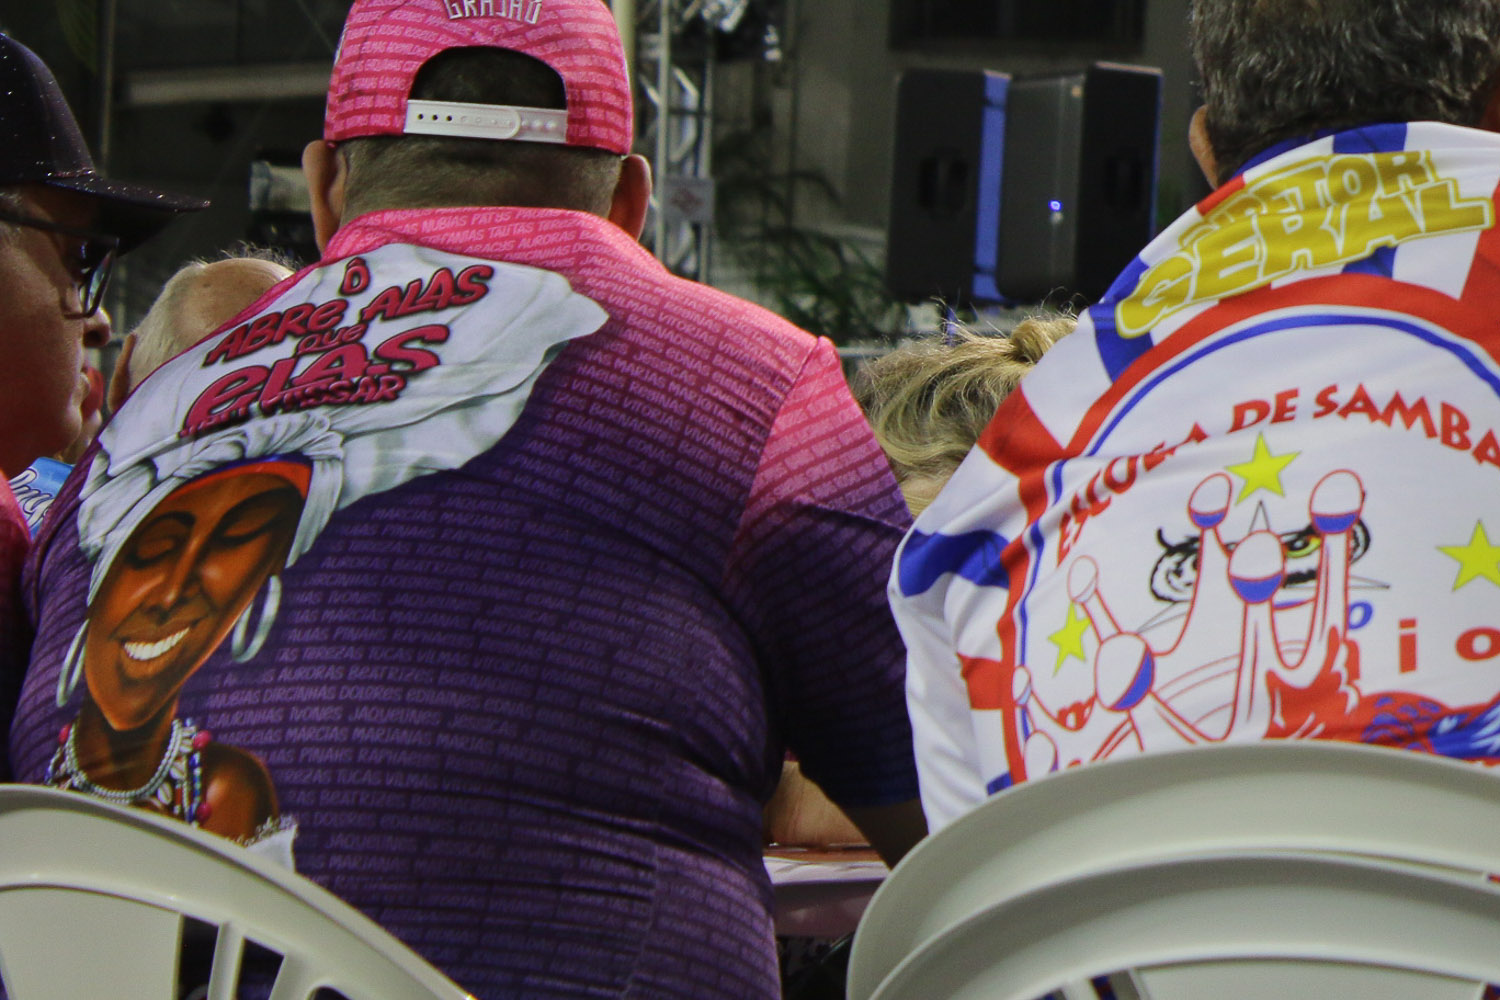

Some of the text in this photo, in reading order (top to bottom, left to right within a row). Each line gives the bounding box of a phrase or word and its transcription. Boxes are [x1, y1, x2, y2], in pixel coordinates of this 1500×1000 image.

[341, 257, 370, 295] Ô
[1116, 178, 1495, 338] GERAL
[359, 264, 494, 320] ALAS
[1227, 388, 1300, 433] DE
